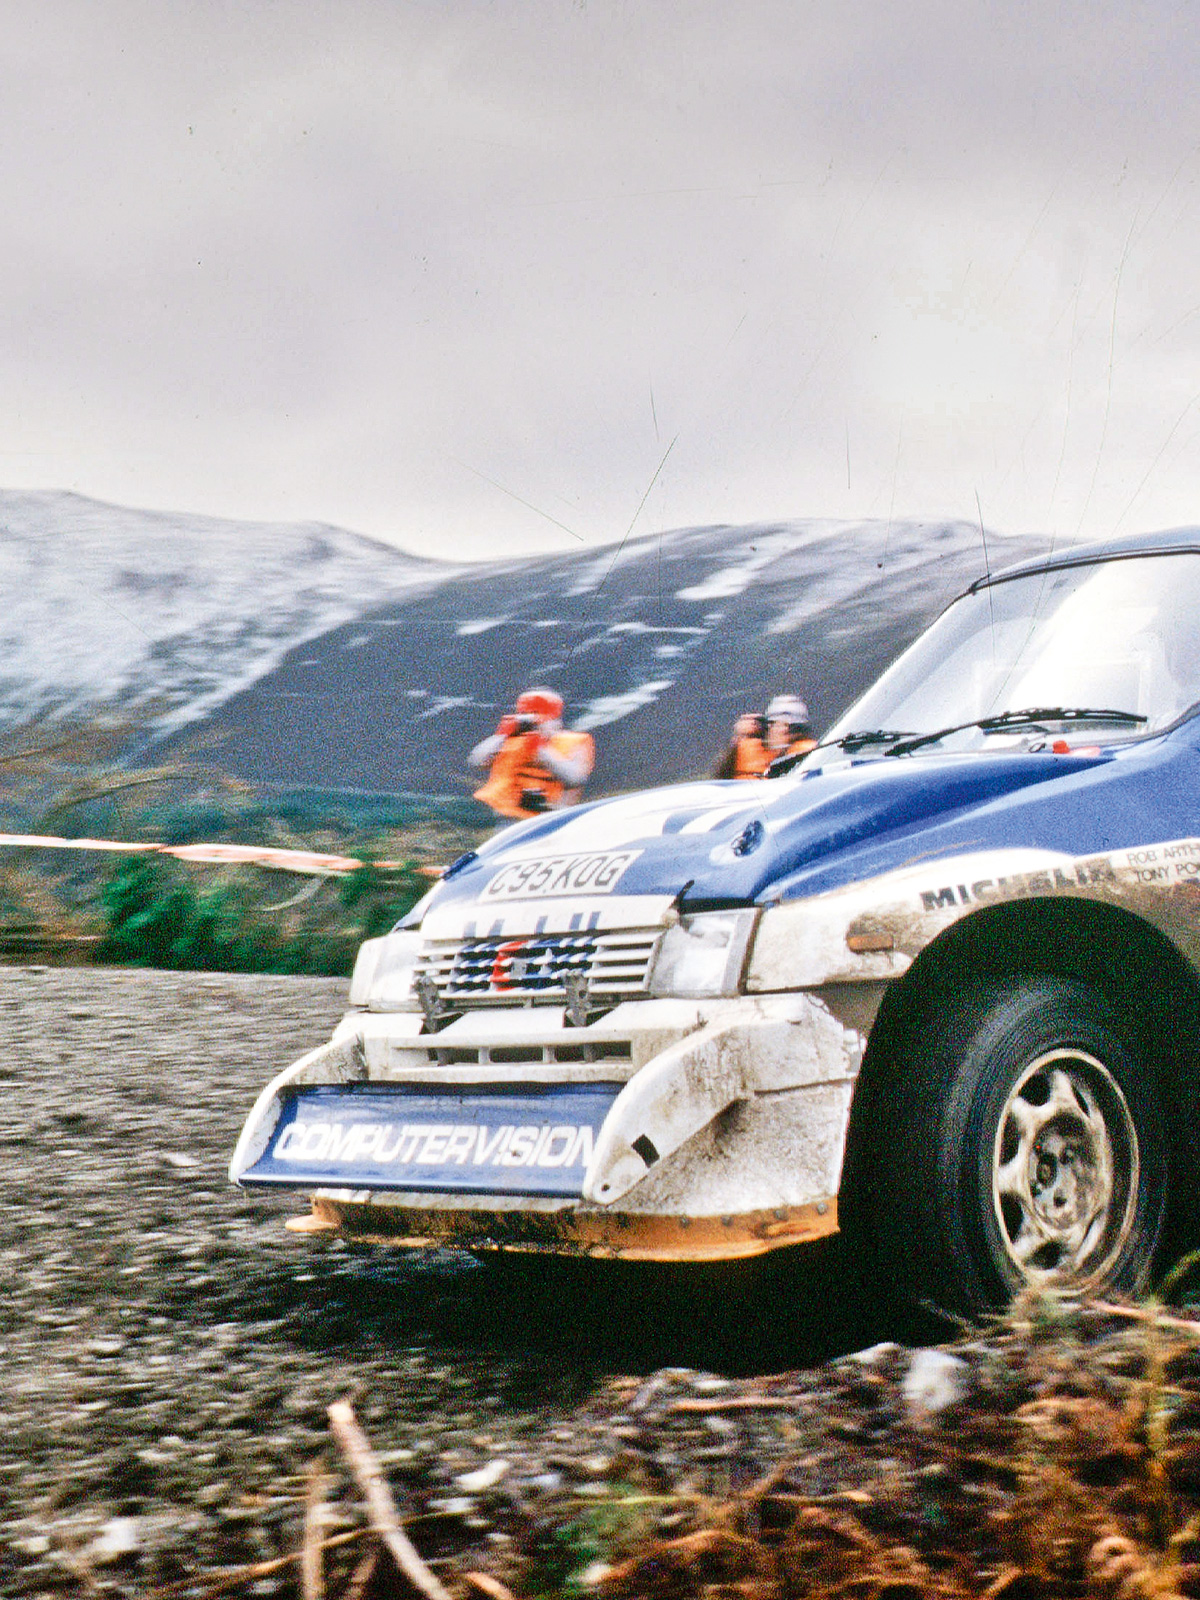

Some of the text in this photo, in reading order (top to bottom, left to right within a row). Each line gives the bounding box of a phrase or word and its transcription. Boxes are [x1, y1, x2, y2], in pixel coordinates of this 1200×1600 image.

[1126, 848, 1158, 867] ROB
[1134, 864, 1170, 883] TONY
[272, 1122, 597, 1168] COMPUTERVISION
